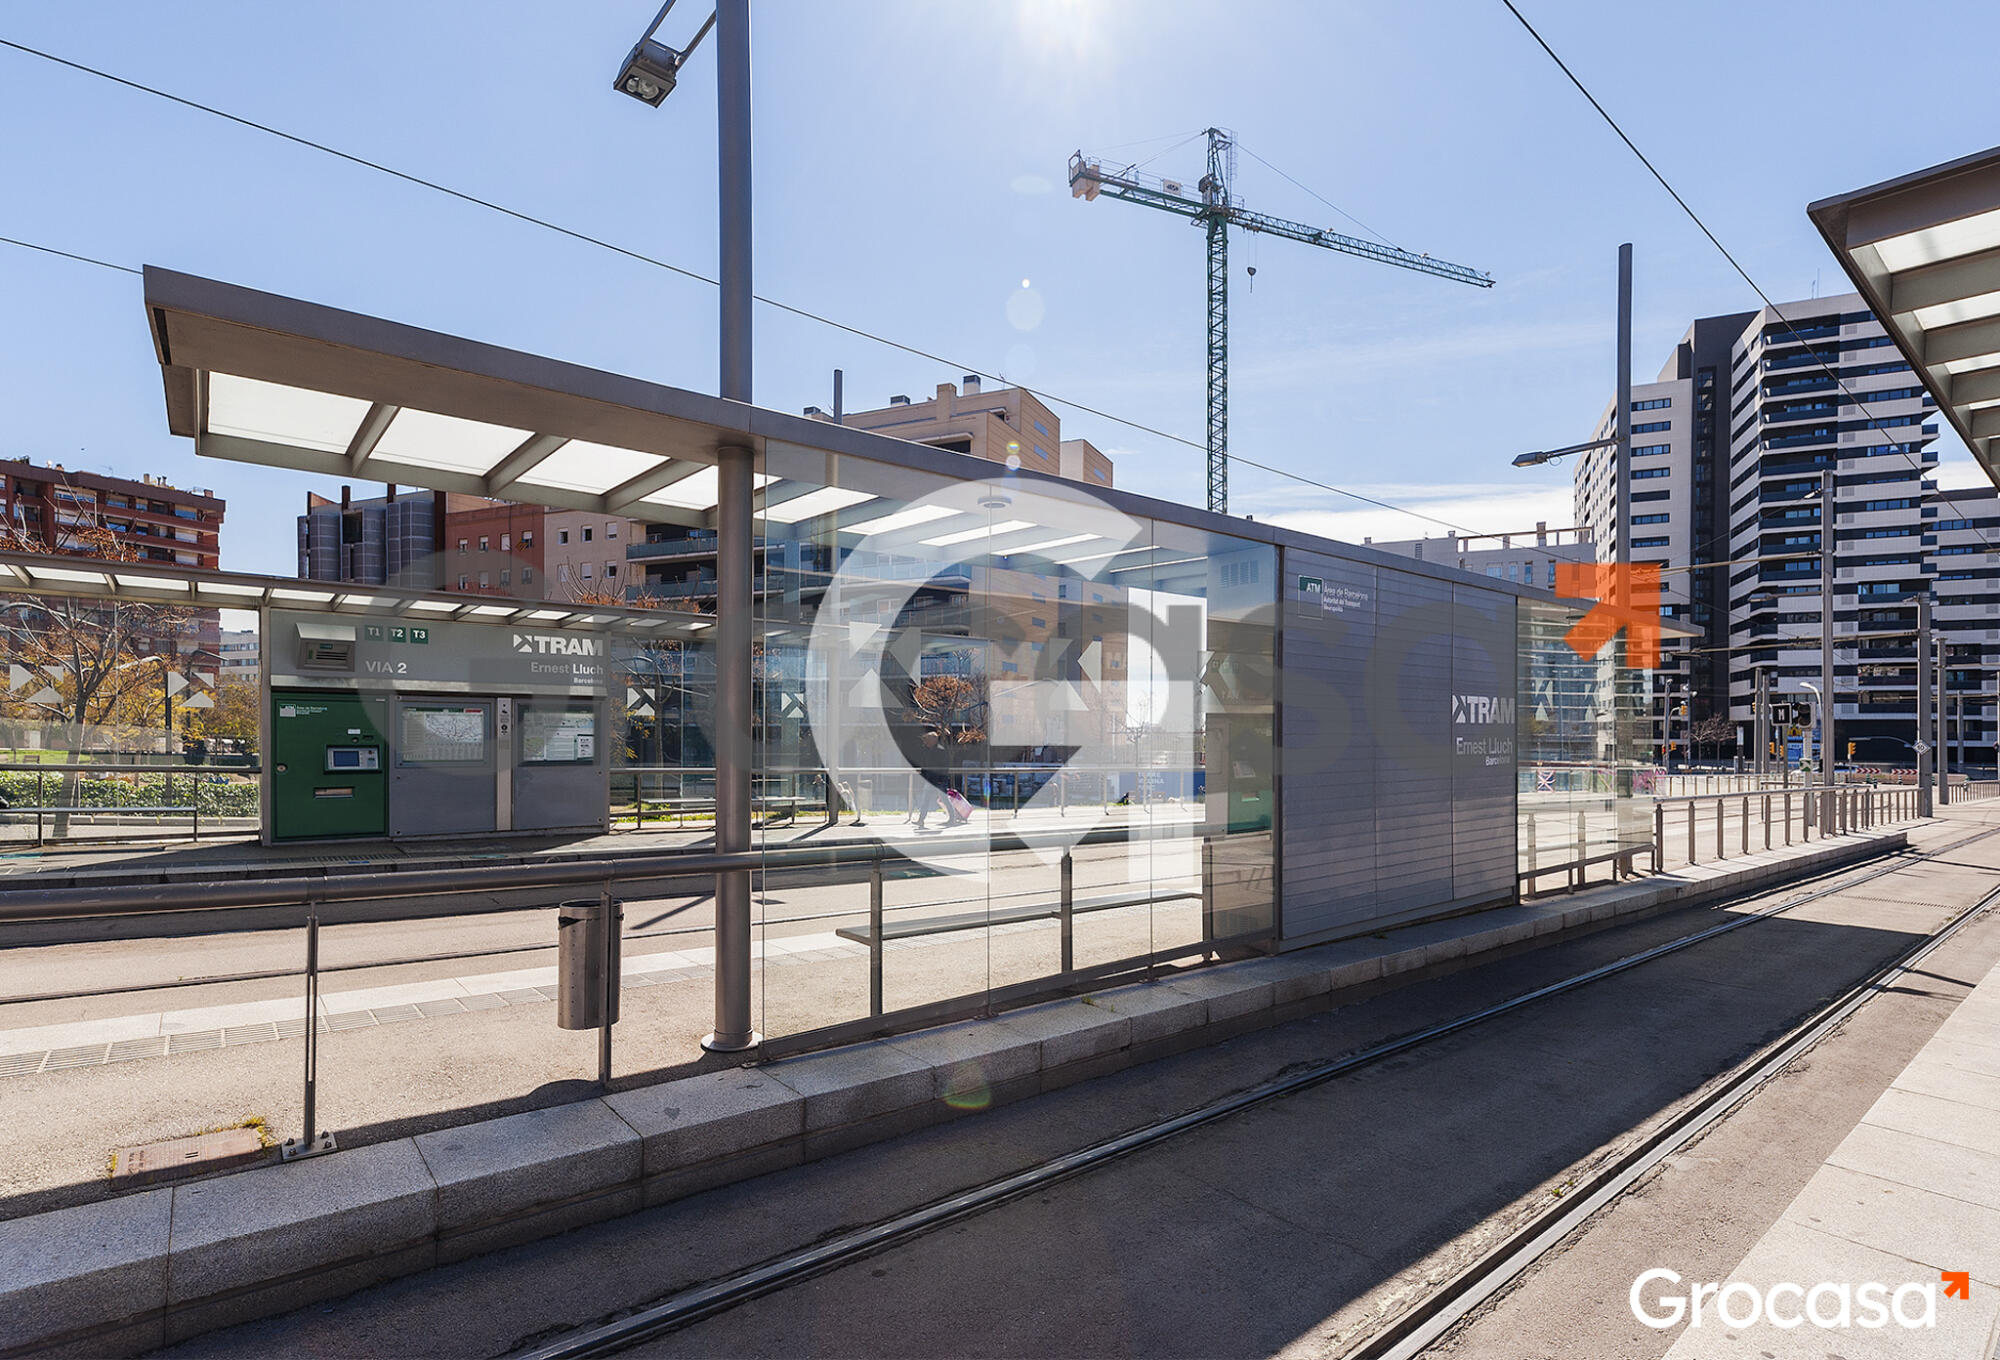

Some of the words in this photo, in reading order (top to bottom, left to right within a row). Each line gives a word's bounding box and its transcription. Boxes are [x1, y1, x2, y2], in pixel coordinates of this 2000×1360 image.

[1306, 582, 1321, 593] ATM
[368, 627, 380, 637] T1
[391, 628, 404, 638] T2
[413, 630, 426, 639] T3
[534, 635, 603, 657] TRAM
[365, 660, 393, 673] VIA
[397, 662, 407, 674] 2
[531, 662, 570, 674] Ernest
[573, 663, 604, 675] Lluch
[1467, 696, 1515, 724] TRAM
[1456, 737, 1486, 755] Ernest
[1488, 737, 1513, 755] Lluch
